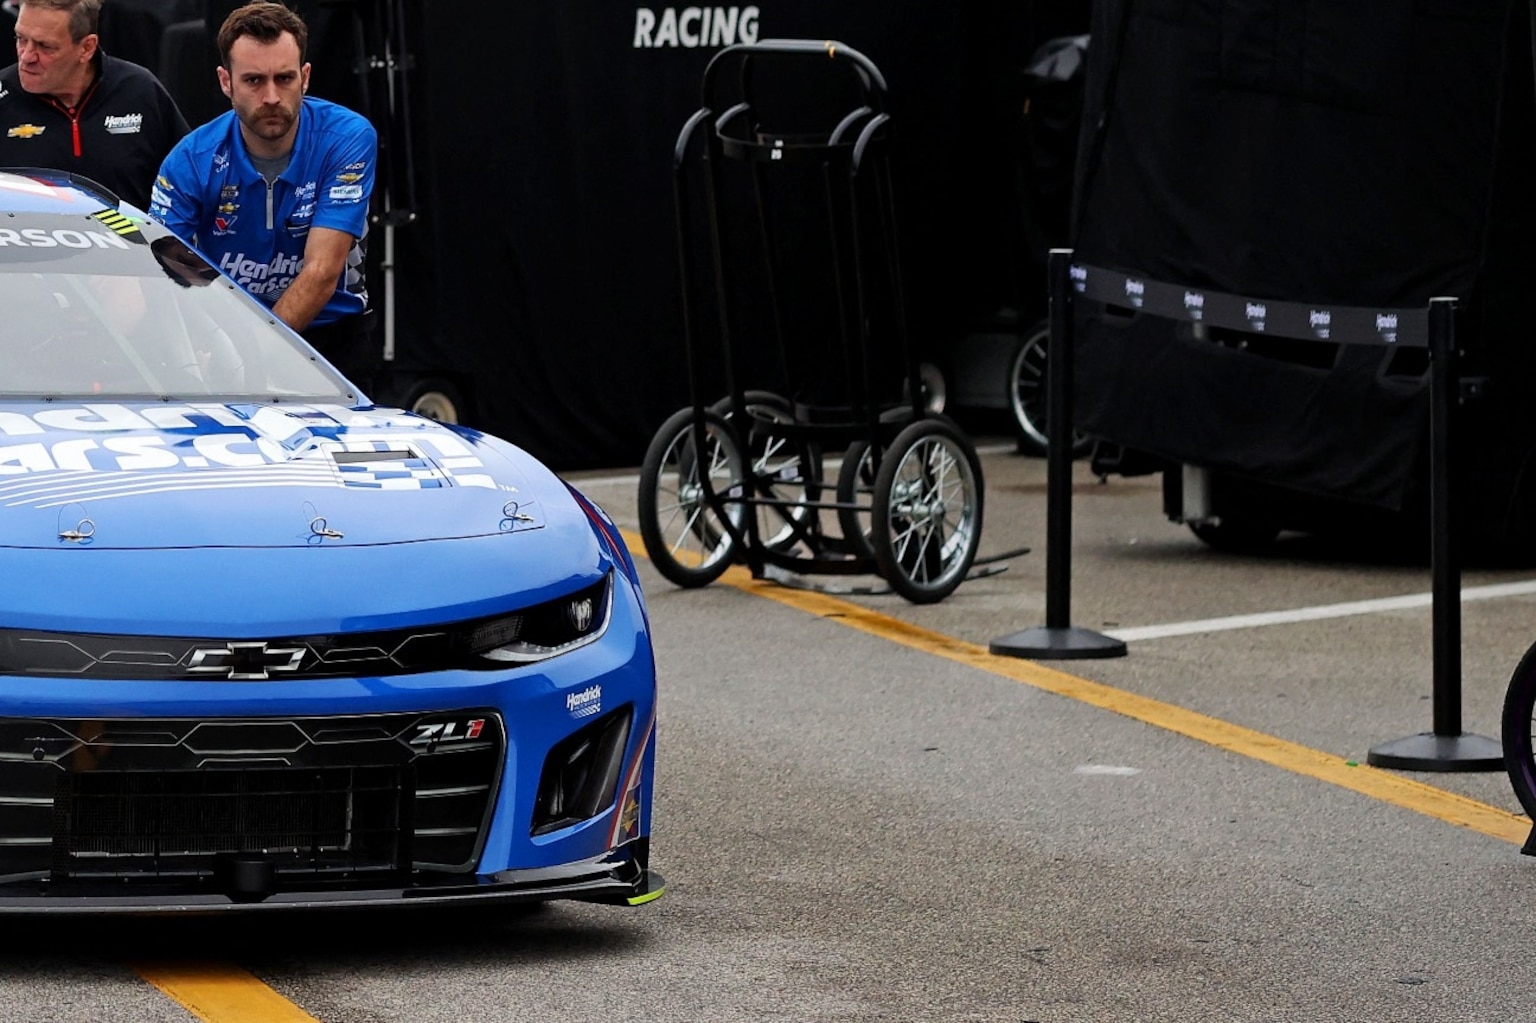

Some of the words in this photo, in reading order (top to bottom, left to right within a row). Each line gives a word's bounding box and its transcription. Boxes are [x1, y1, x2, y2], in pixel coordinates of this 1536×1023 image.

[633, 6, 761, 49] RACING
[104, 112, 144, 129] Hendrick
[566, 684, 602, 711] Hendrick
[409, 718, 486, 745] ZL1
